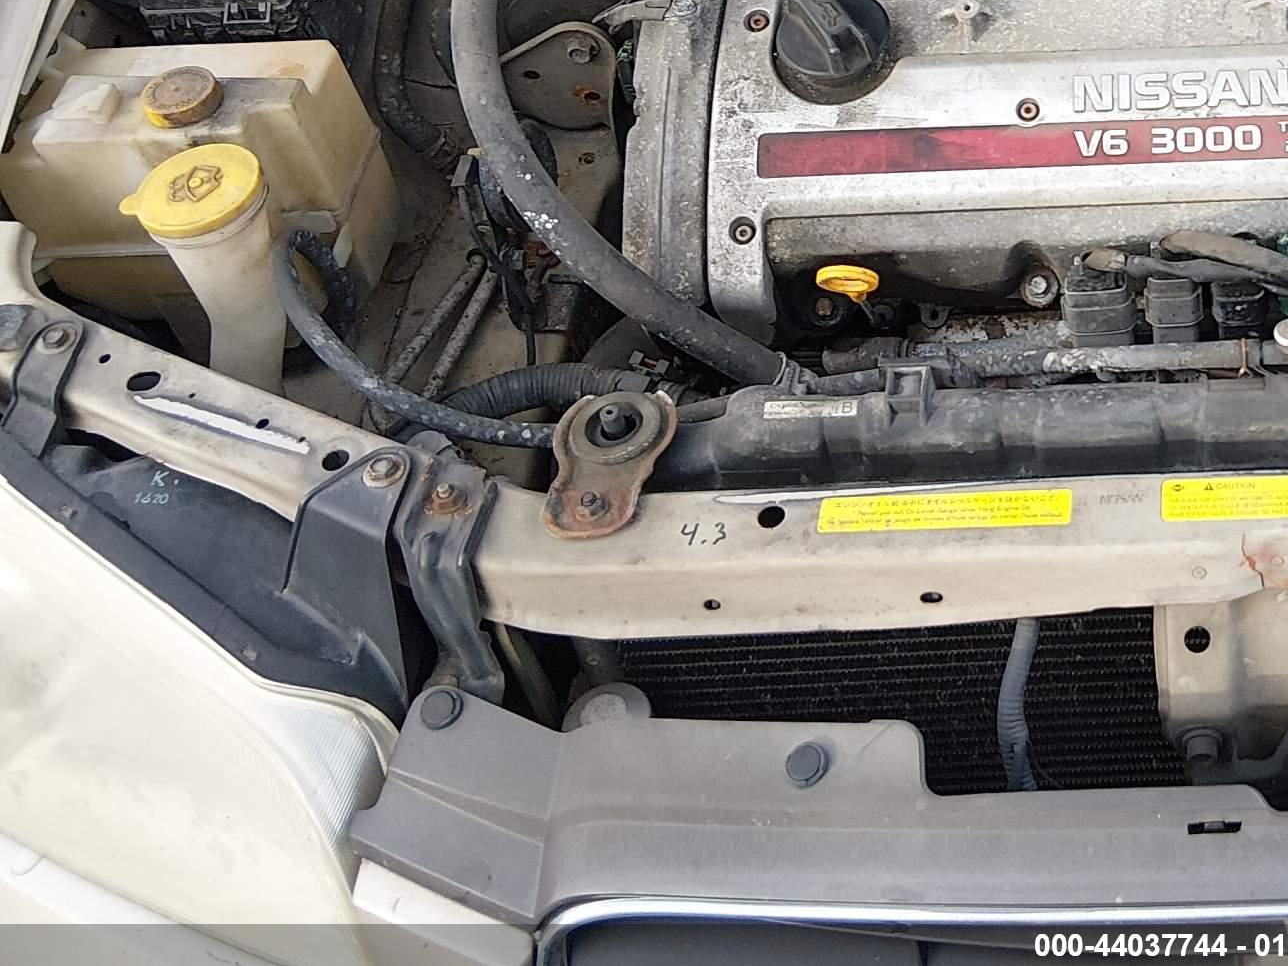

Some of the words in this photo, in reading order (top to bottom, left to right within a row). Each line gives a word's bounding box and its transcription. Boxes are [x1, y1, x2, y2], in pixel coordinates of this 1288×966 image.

[1073, 129, 1130, 158] V6
[1150, 124, 1263, 155] 3000
[1215, 482, 1256, 491] CAUTION
[680, 522, 727, 546] 4.3
